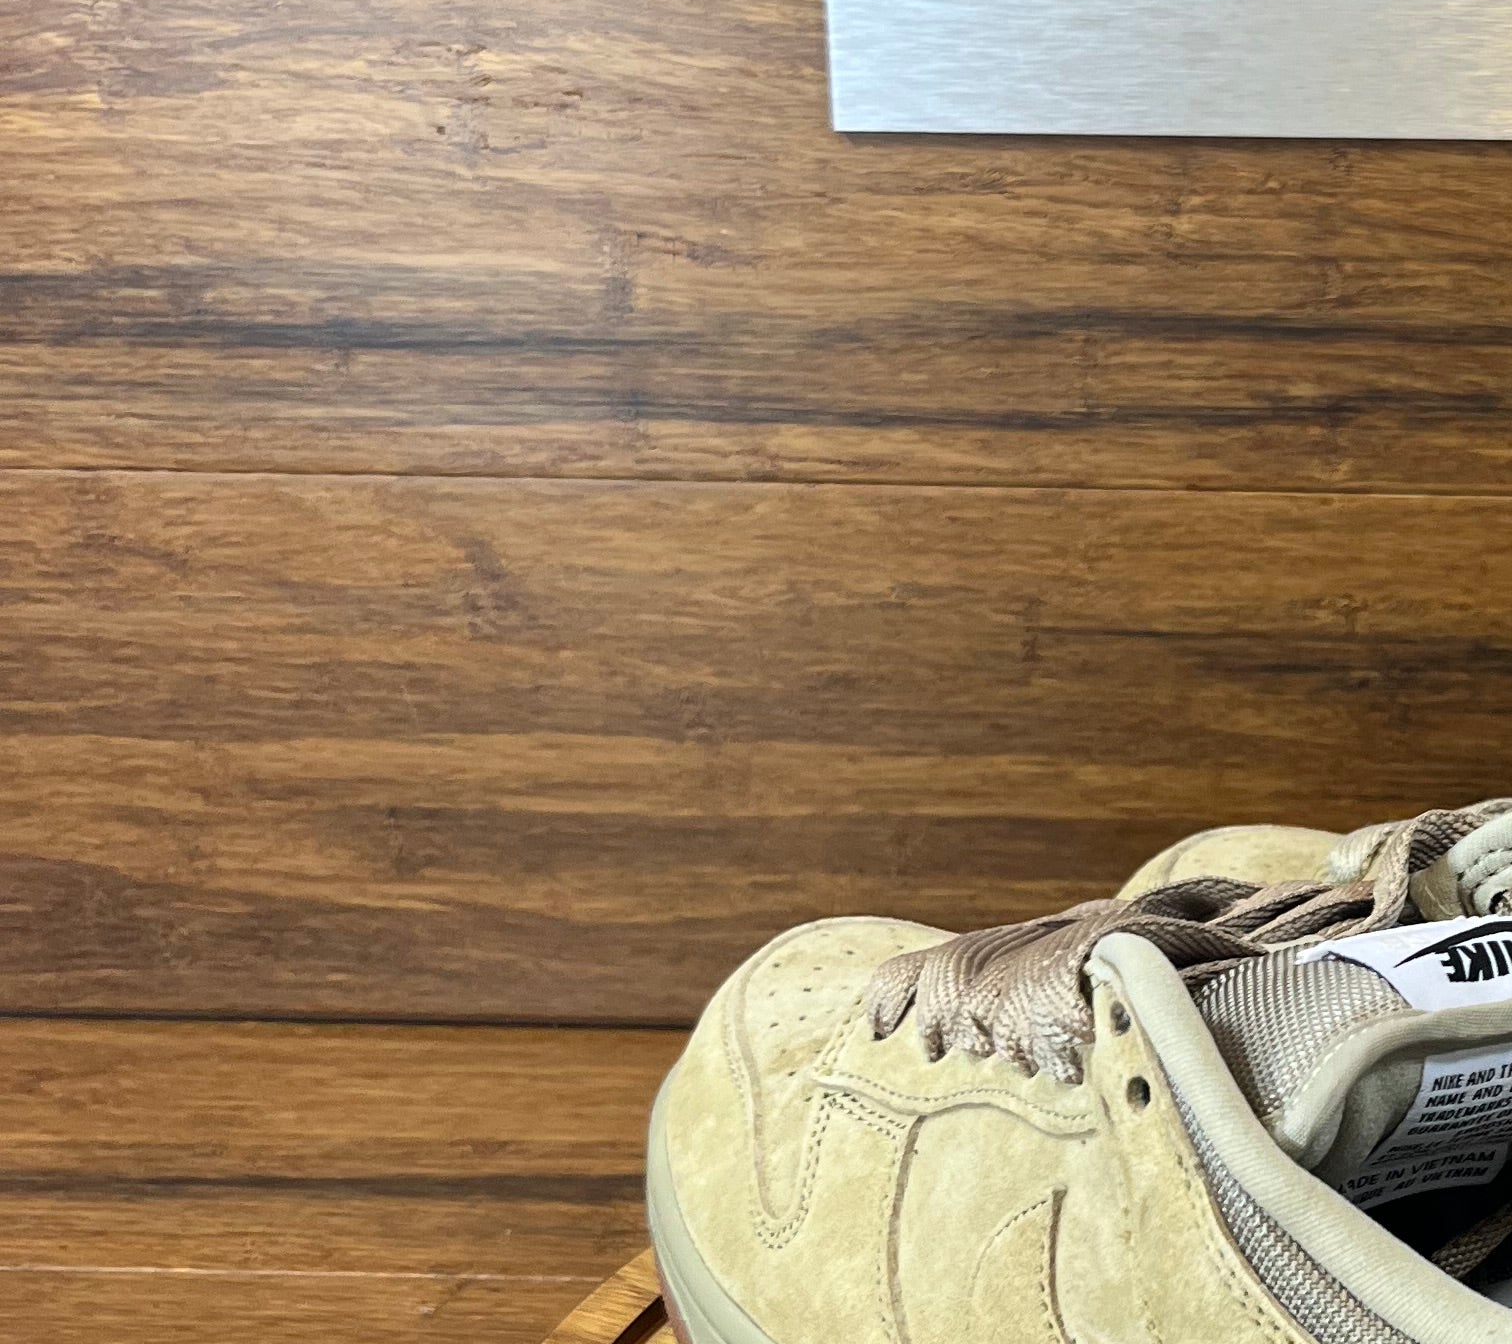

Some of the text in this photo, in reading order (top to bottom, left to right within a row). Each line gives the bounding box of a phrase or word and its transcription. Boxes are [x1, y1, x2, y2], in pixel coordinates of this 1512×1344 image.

[1432, 1074, 1463, 1091] NIKE
[1466, 1068, 1495, 1086] AND
[1425, 1092, 1465, 1108] NAME
[1472, 1085, 1503, 1100] AND
[1418, 1097, 1512, 1123] TRADEMARKS
[1386, 1168, 1405, 1181] IN
[1412, 1150, 1496, 1174] VIETNAM
